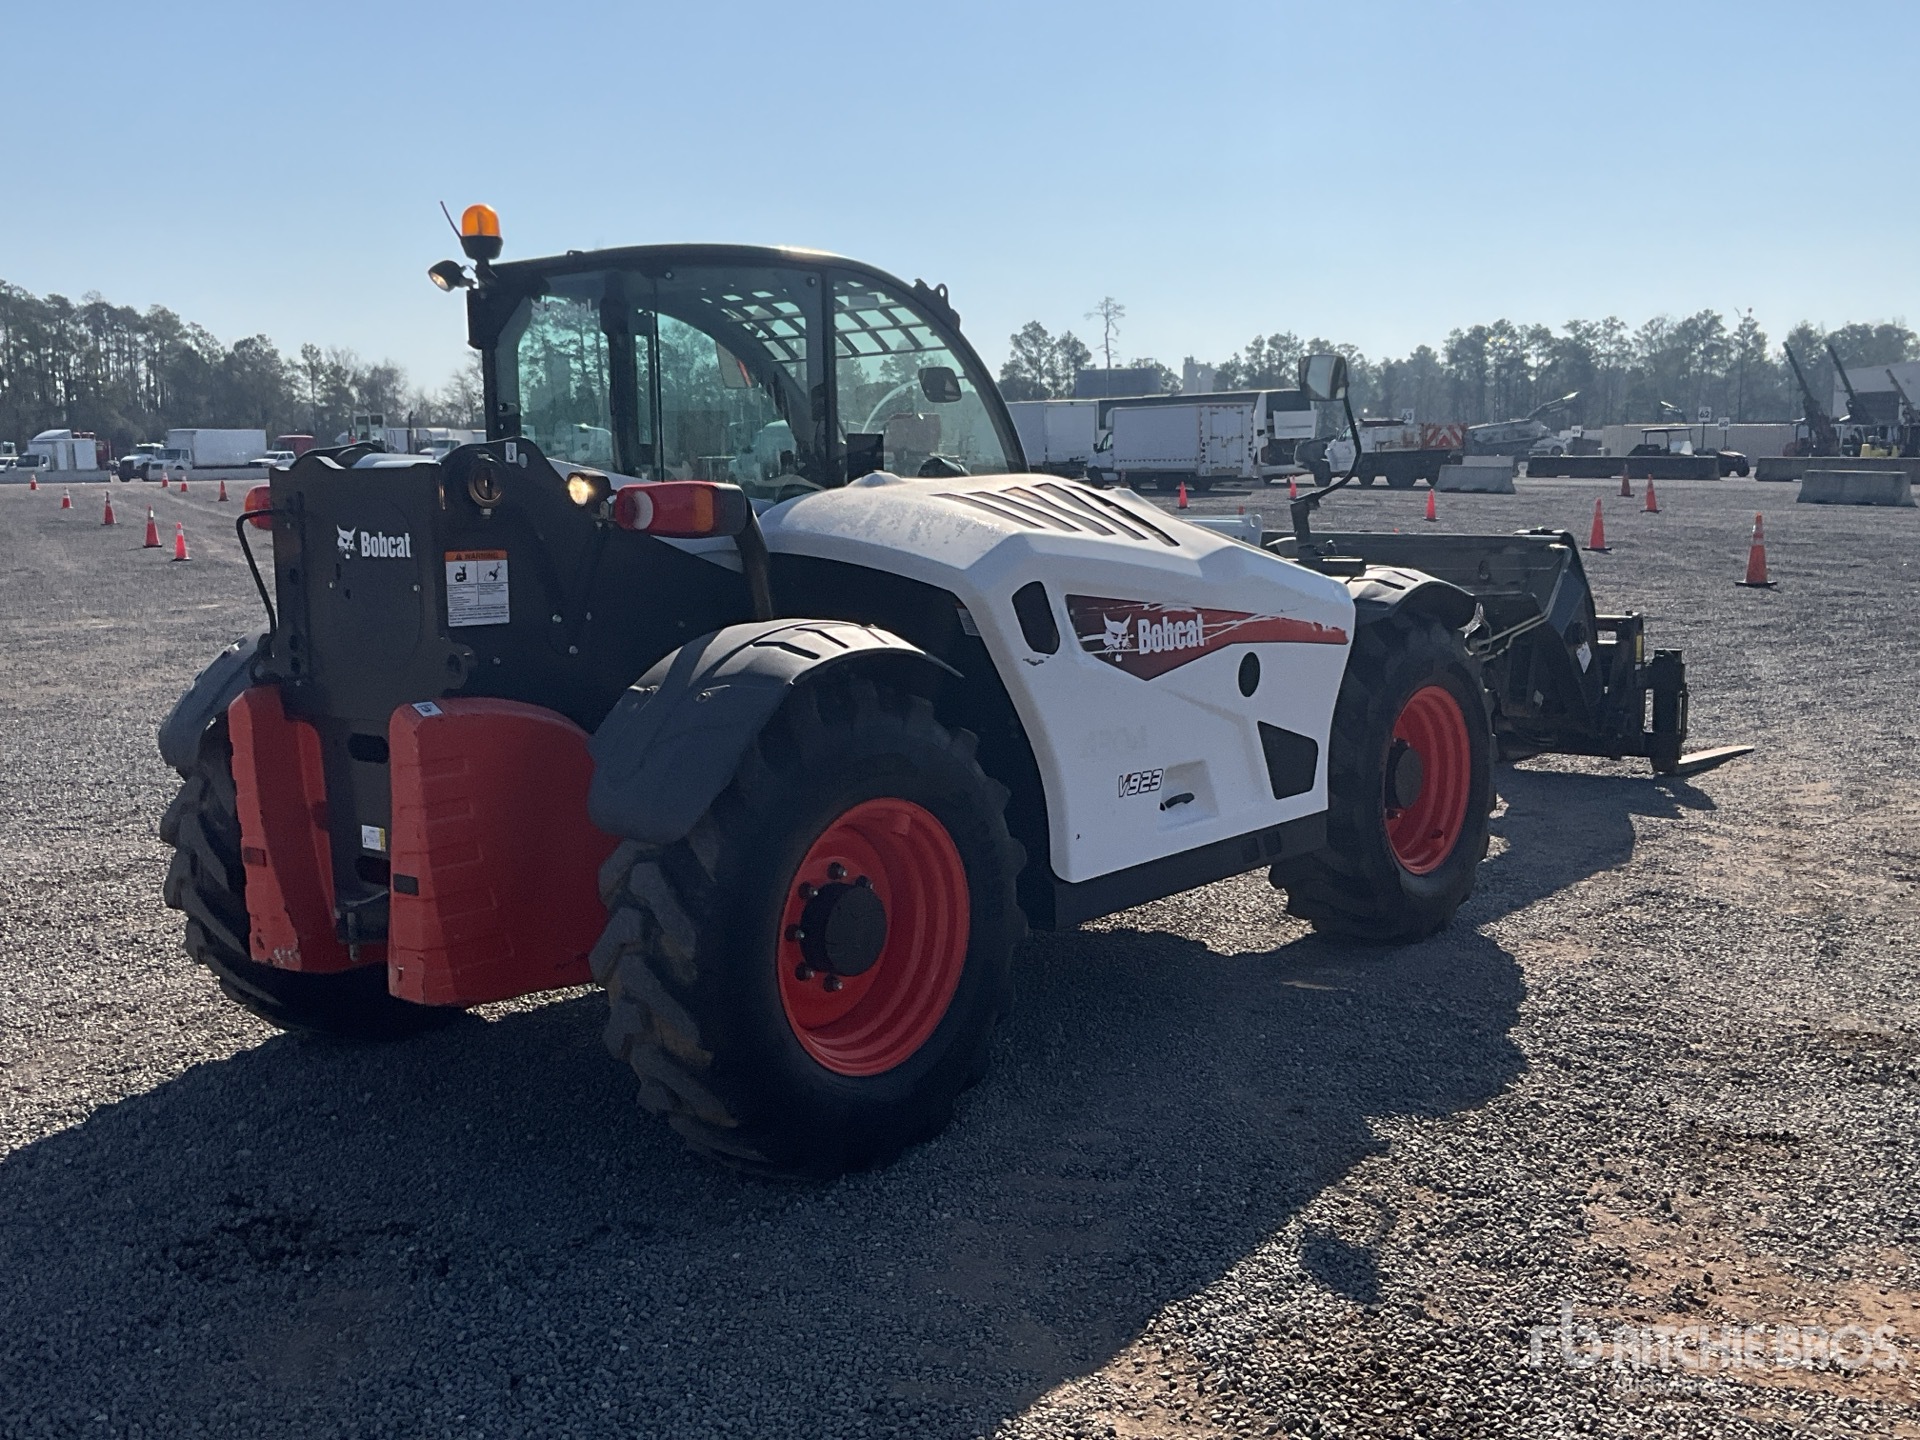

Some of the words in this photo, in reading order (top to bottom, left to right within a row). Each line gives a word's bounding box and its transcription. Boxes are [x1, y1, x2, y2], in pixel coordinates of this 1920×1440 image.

[1699, 410, 1710, 419] 62
[360, 531, 411, 558] Bobcat
[1137, 613, 1205, 655] Bobcat
[1118, 768, 1164, 798] V923
